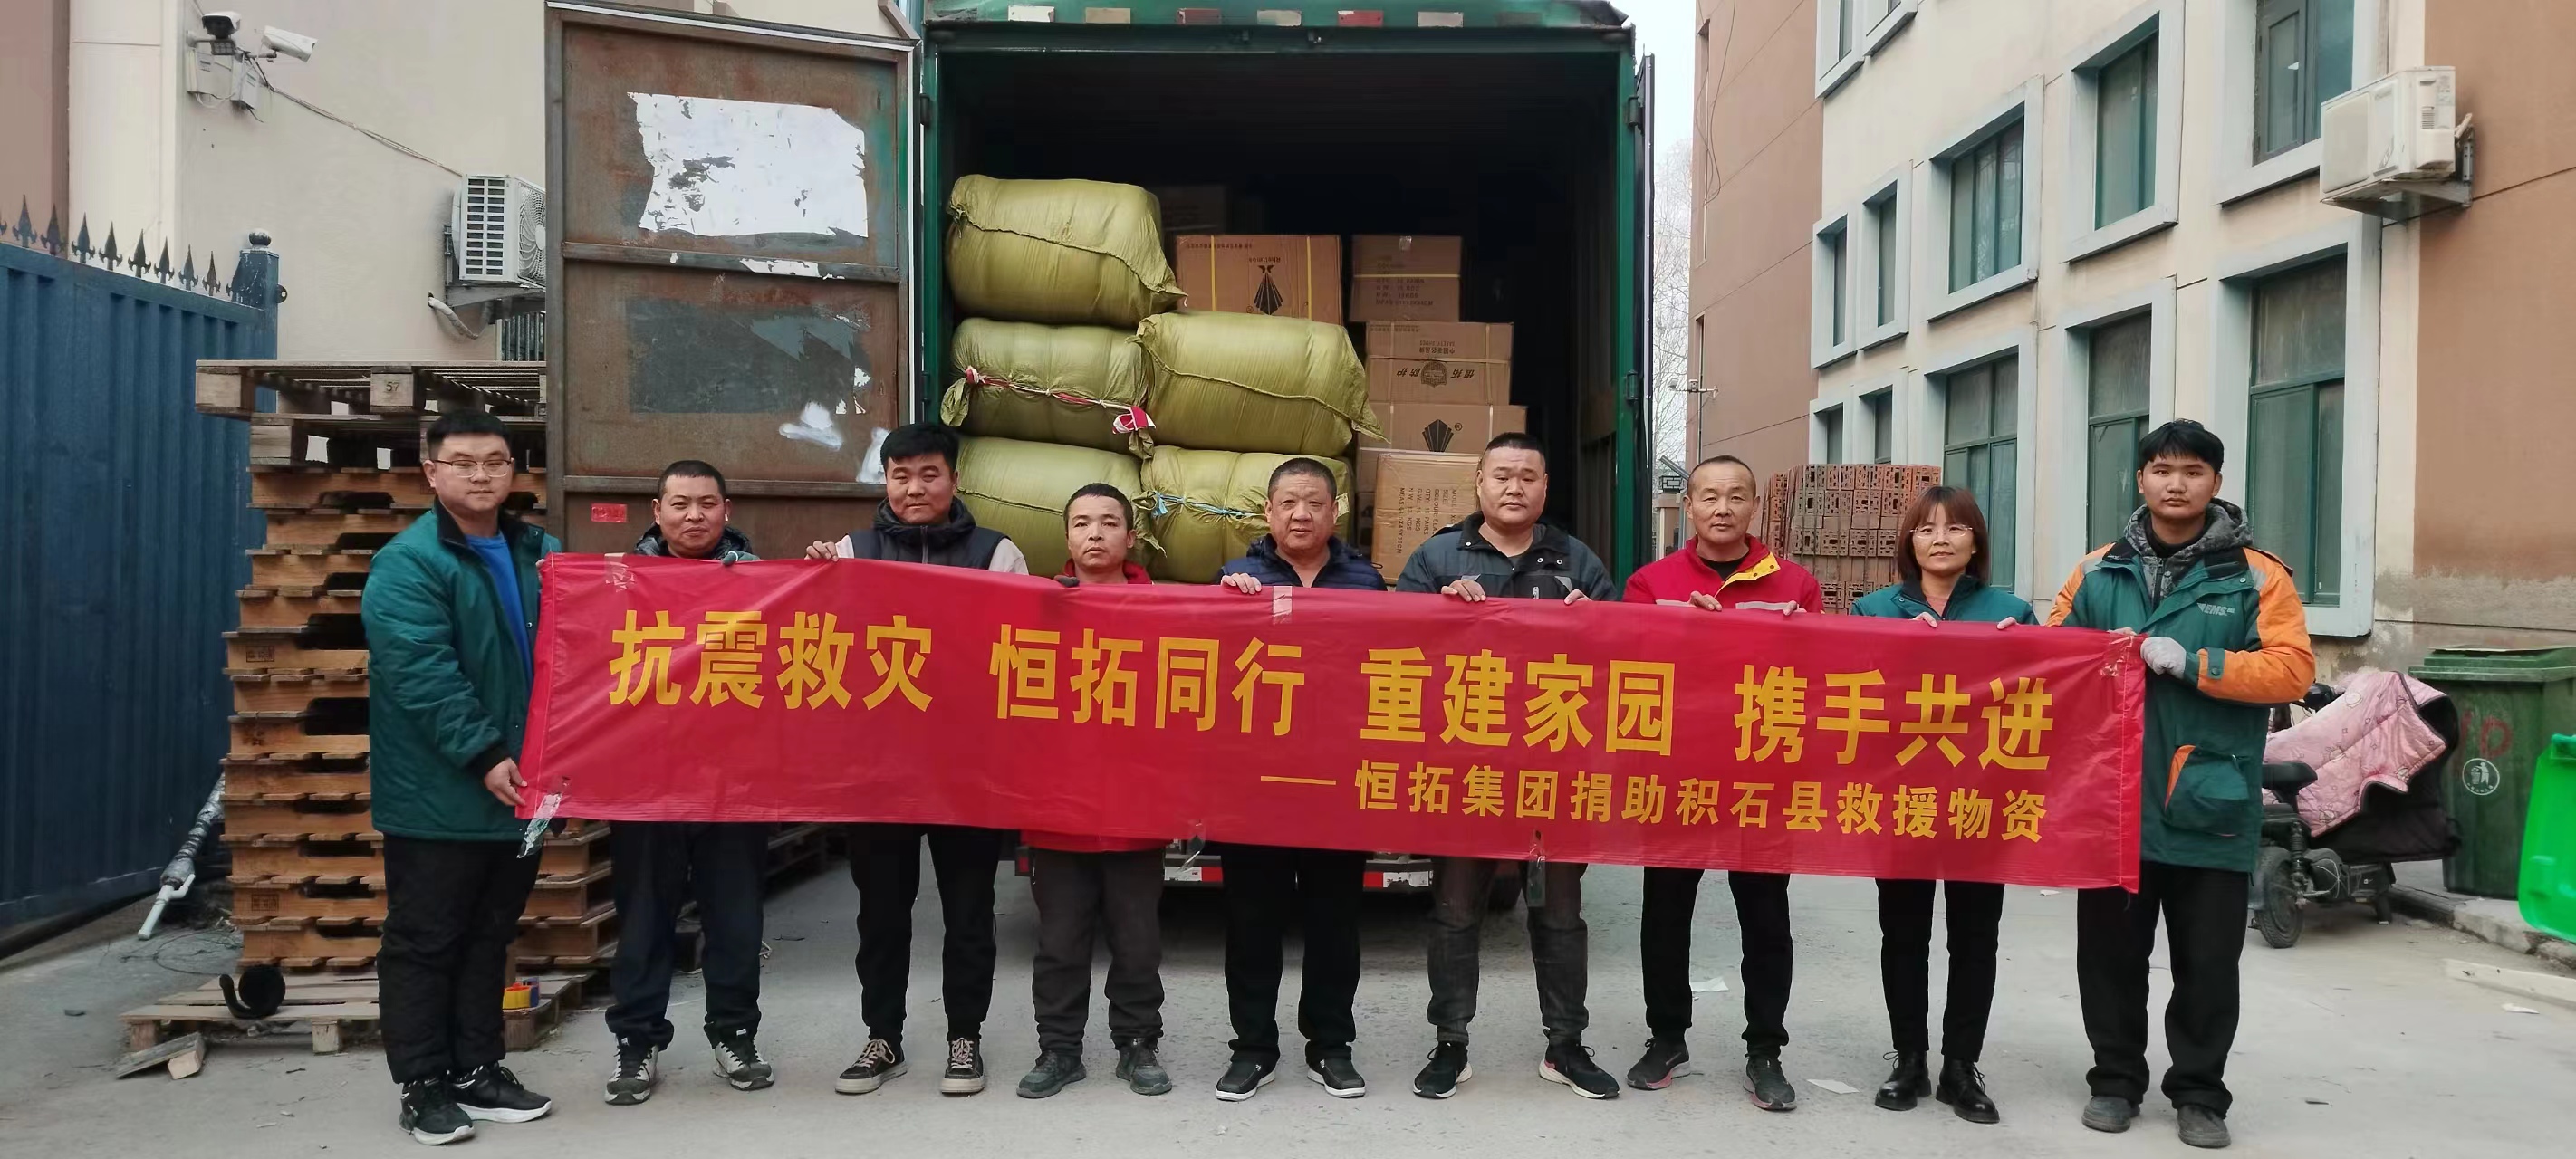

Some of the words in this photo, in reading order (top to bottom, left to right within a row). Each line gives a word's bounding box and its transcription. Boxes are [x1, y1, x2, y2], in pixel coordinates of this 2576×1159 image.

[386, 381, 399, 392] 57
[2204, 604, 2228, 616] EMS
[609, 609, 932, 710] 抗震救灾
[989, 625, 1306, 736] 恒拓同行
[1360, 647, 1675, 756] 重建家园
[1734, 665, 2053, 770] 携手共进
